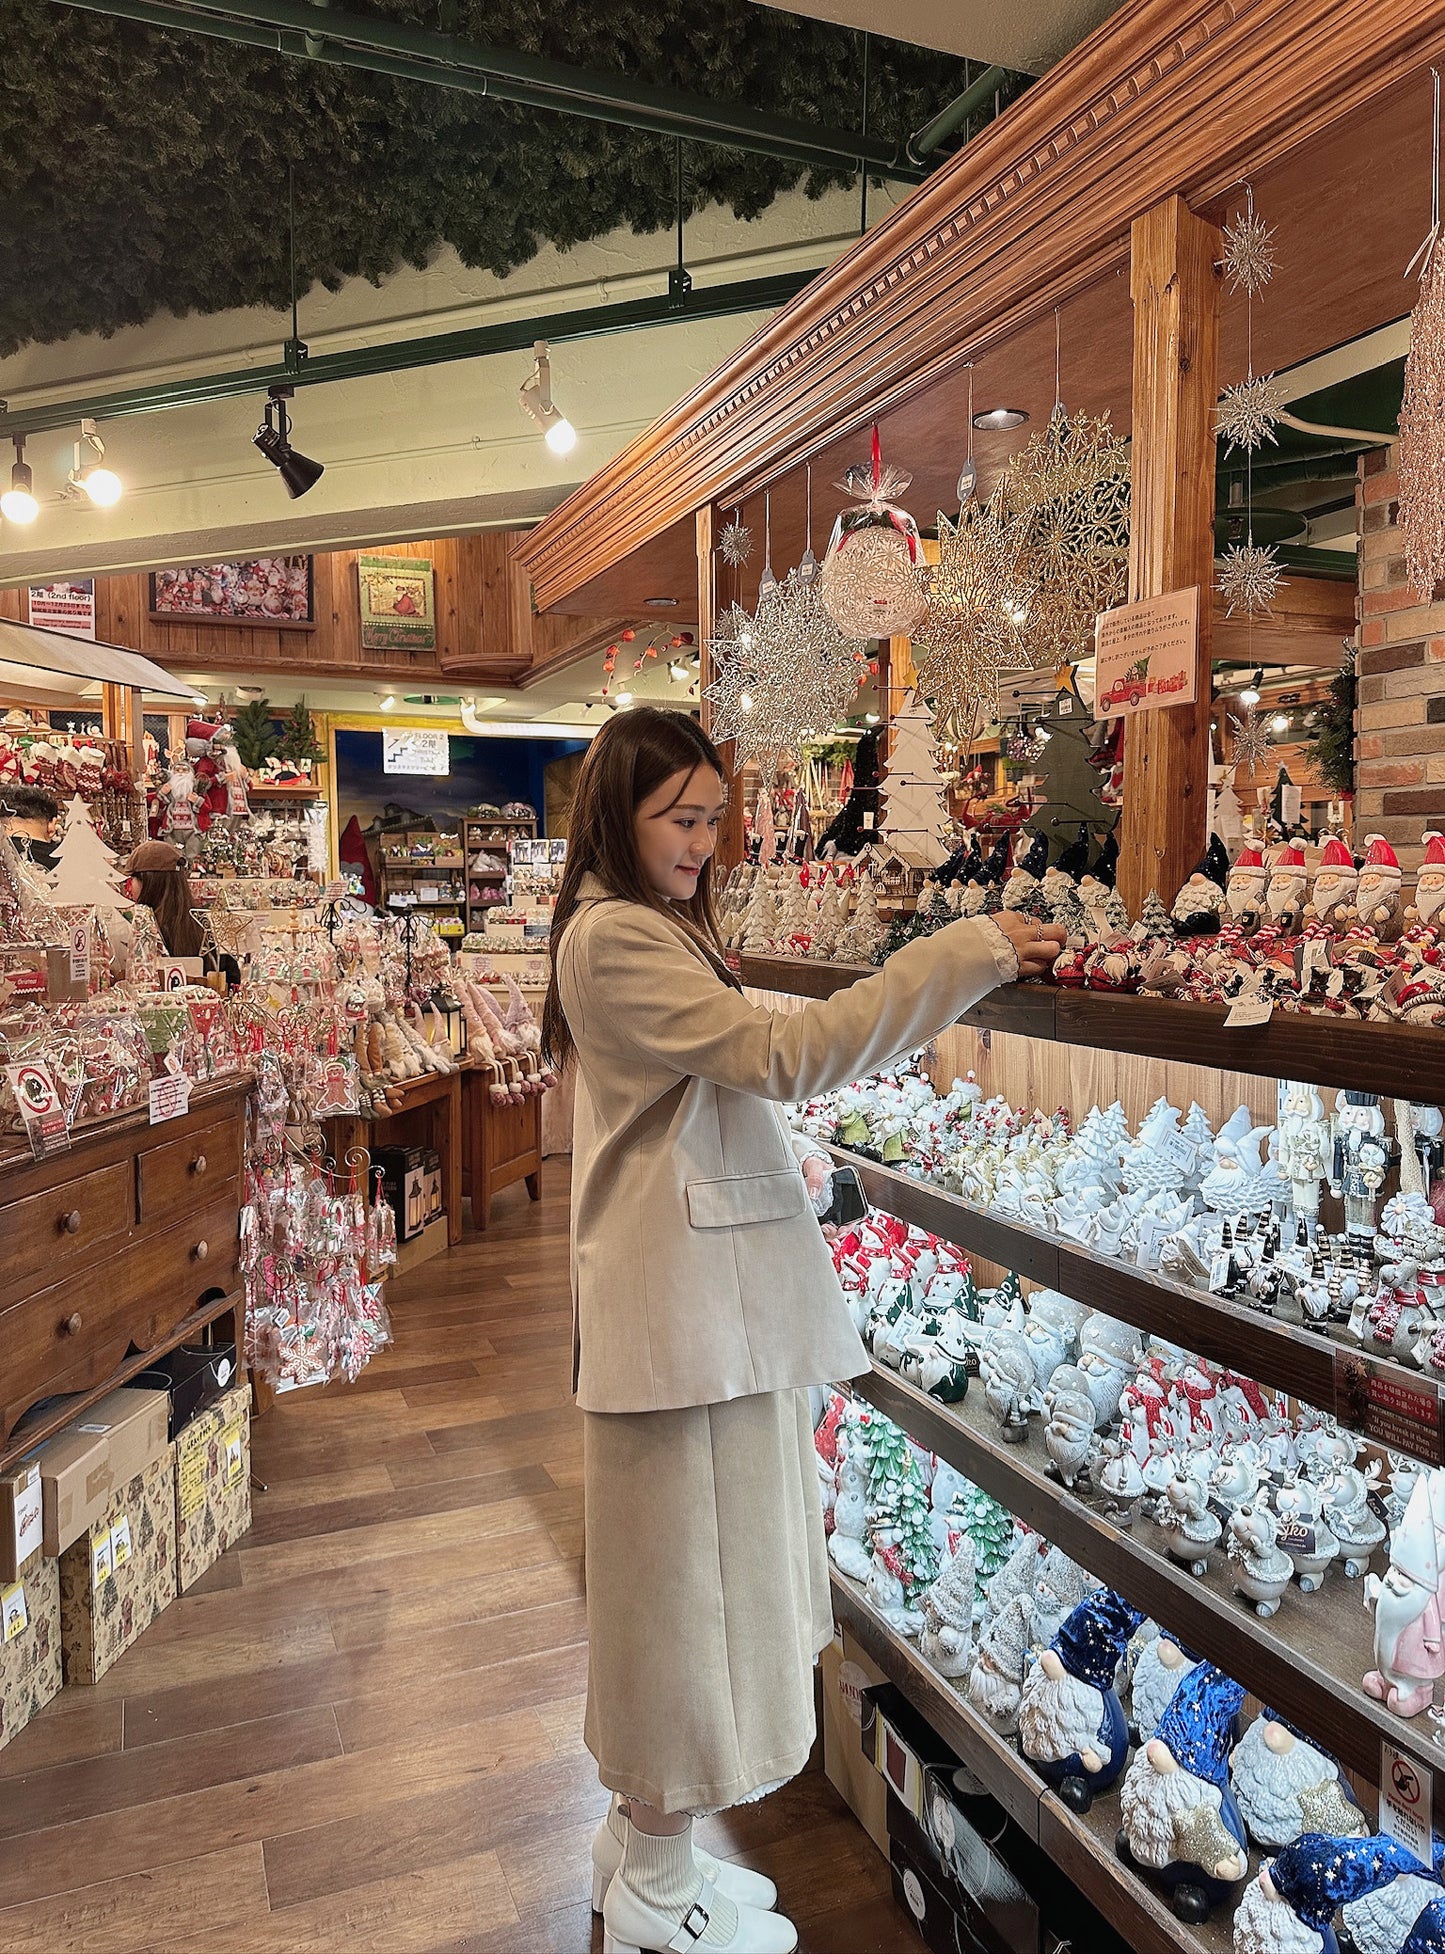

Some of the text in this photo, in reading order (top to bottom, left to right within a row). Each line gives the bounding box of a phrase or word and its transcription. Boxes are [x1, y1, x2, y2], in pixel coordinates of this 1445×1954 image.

[1369, 1424, 1384, 1435] YOU
[1384, 1429, 1402, 1443] WILL
[1402, 1436, 1415, 1450] PAY
[1396, 1815, 1418, 1836] ください
